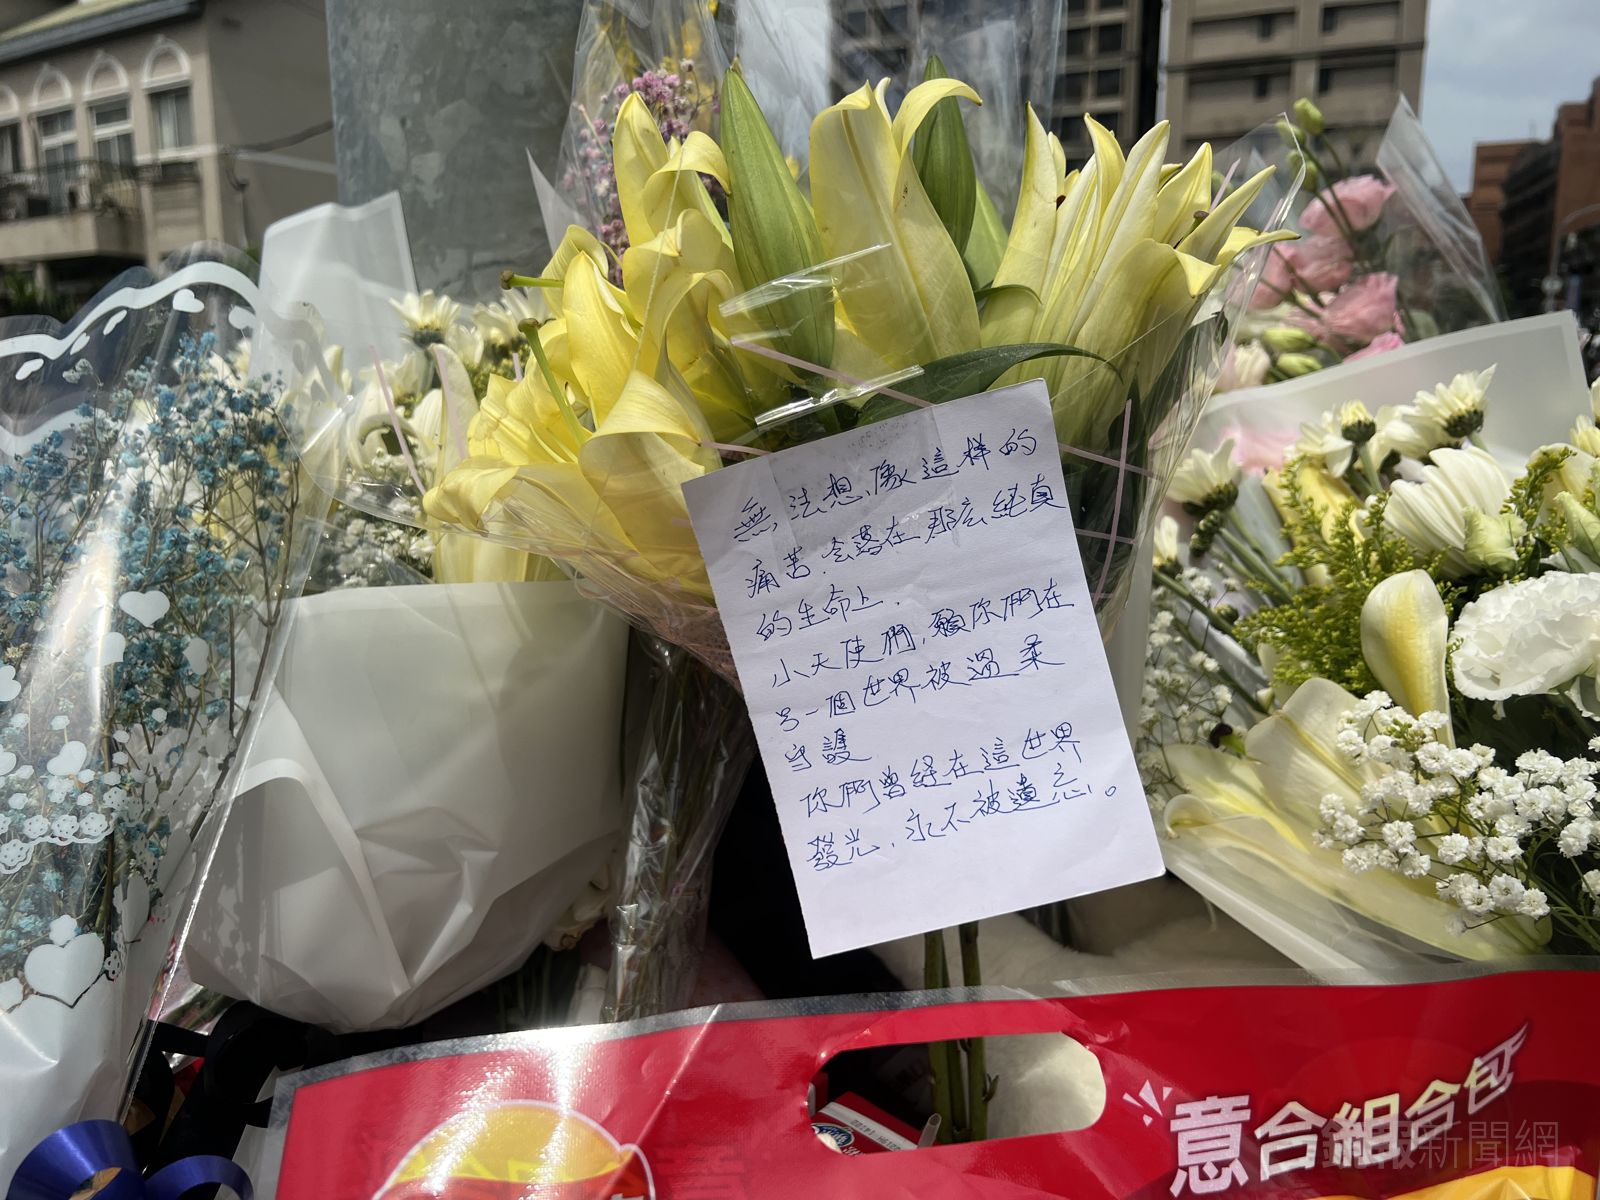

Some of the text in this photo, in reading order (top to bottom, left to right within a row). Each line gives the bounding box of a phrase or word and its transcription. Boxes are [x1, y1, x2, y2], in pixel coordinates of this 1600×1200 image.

[784, 727, 872, 772] 守護
[1169, 1022, 1529, 1198] 意合組合包
